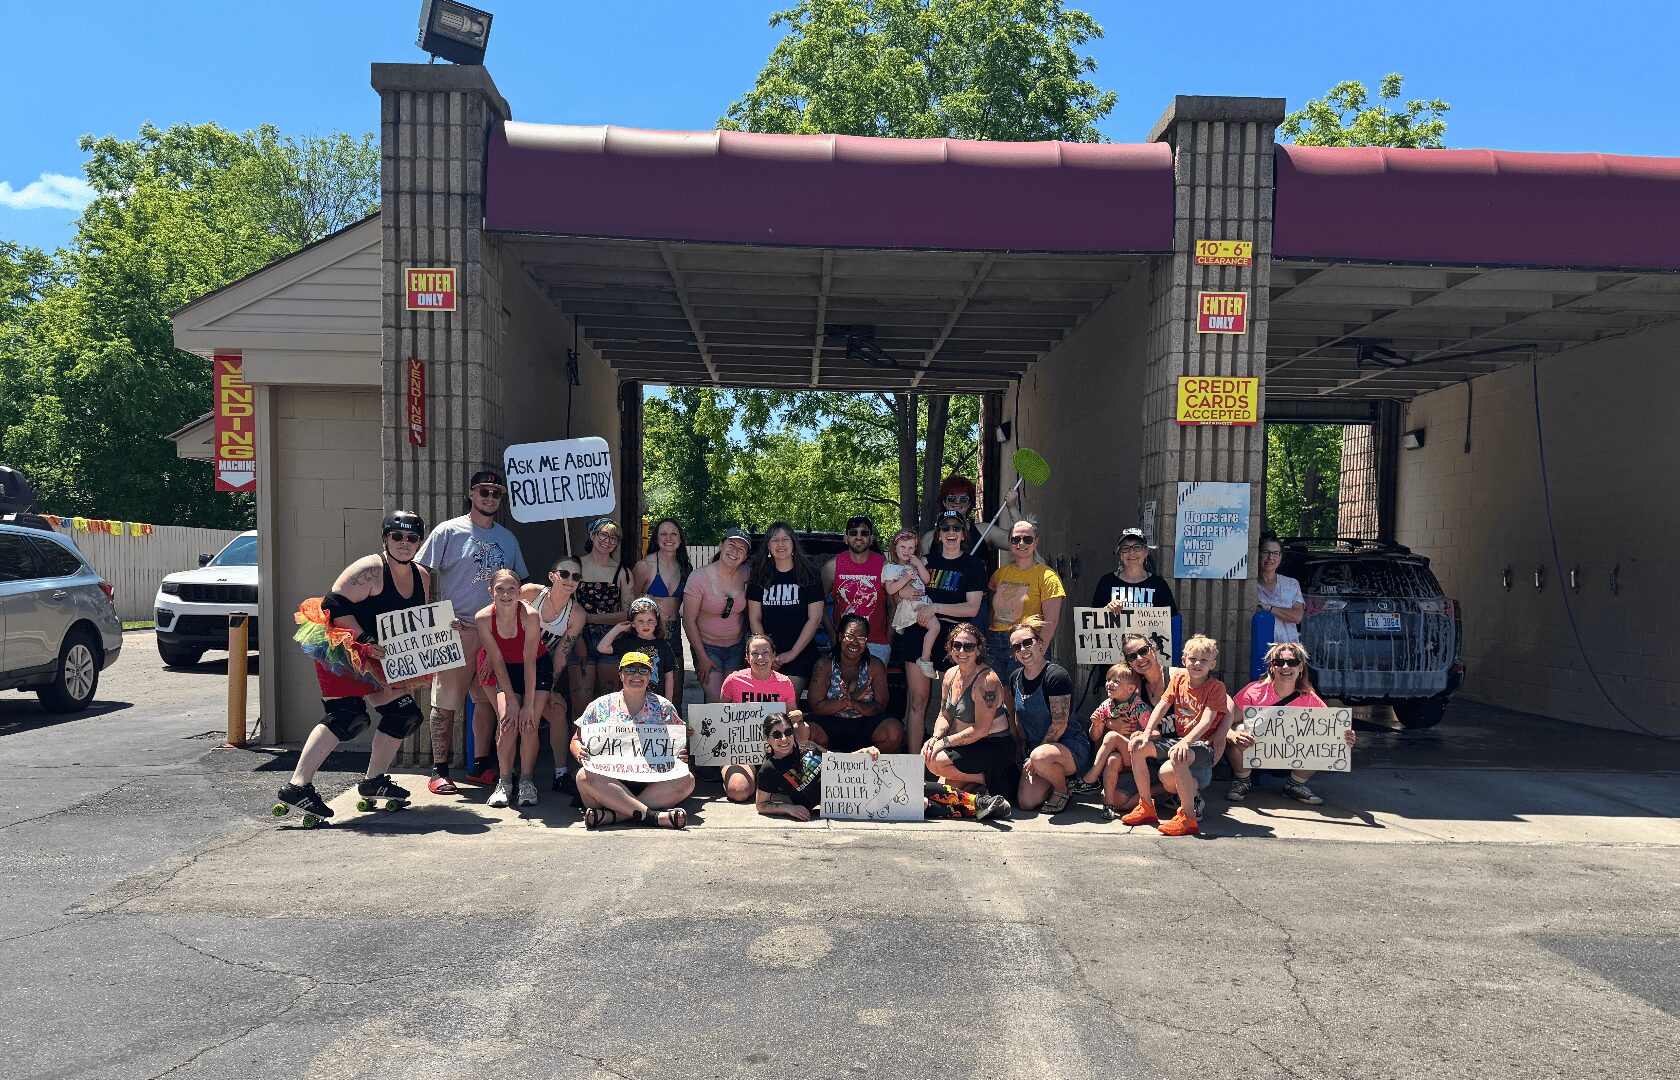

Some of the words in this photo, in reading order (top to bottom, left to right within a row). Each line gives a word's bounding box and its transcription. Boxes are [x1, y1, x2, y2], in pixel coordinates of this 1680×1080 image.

[1198, 257, 1248, 265] CLEARANCE
[411, 273, 451, 292] ENTER
[418, 293, 443, 306] ONLY
[1203, 296, 1242, 316] ENTER
[1208, 316, 1234, 329] ONLY
[411, 359, 422, 425] VENDING
[1184, 379, 1252, 394] CREDIT
[219, 360, 254, 459] VENDING
[1186, 394, 1249, 409] CARDS
[1183, 410, 1251, 419] ACCEPTED
[218, 460, 256, 471] MACHINE
[507, 458, 535, 475] ASK
[539, 455, 560, 472] ME
[564, 451, 611, 470] ABOUT
[510, 476, 574, 507] ROLLER
[577, 471, 612, 501] DERBY
[1184, 510, 1218, 524] Floors
[1220, 513, 1240, 524] are
[1184, 525, 1233, 538] SLIPPERY
[1183, 538, 1213, 550] when
[1183, 552, 1211, 566] WET
[762, 584, 801, 601] FLINT
[1111, 586, 1156, 602] FLINT
[380, 605, 439, 641] FLINT
[1081, 610, 1134, 629] FLINT
[1137, 619, 1164, 627] DERBY
[422, 629, 453, 648] DERBY
[386, 655, 418, 680] CAR
[418, 643, 462, 670] WASH
[720, 705, 764, 724] Support
[728, 724, 764, 744] FLIN
[1253, 717, 1285, 739] CAR
[1294, 717, 1337, 737] WASH
[587, 735, 623, 757] CAR
[631, 737, 676, 758] WASH
[1254, 742, 1347, 759] FUNDRAISER
[730, 755, 766, 765] DERBY
[826, 755, 868, 773] Support
[838, 774, 868, 785] Local
[825, 785, 868, 799] ROLLER
[824, 801, 862, 815] DERBY
